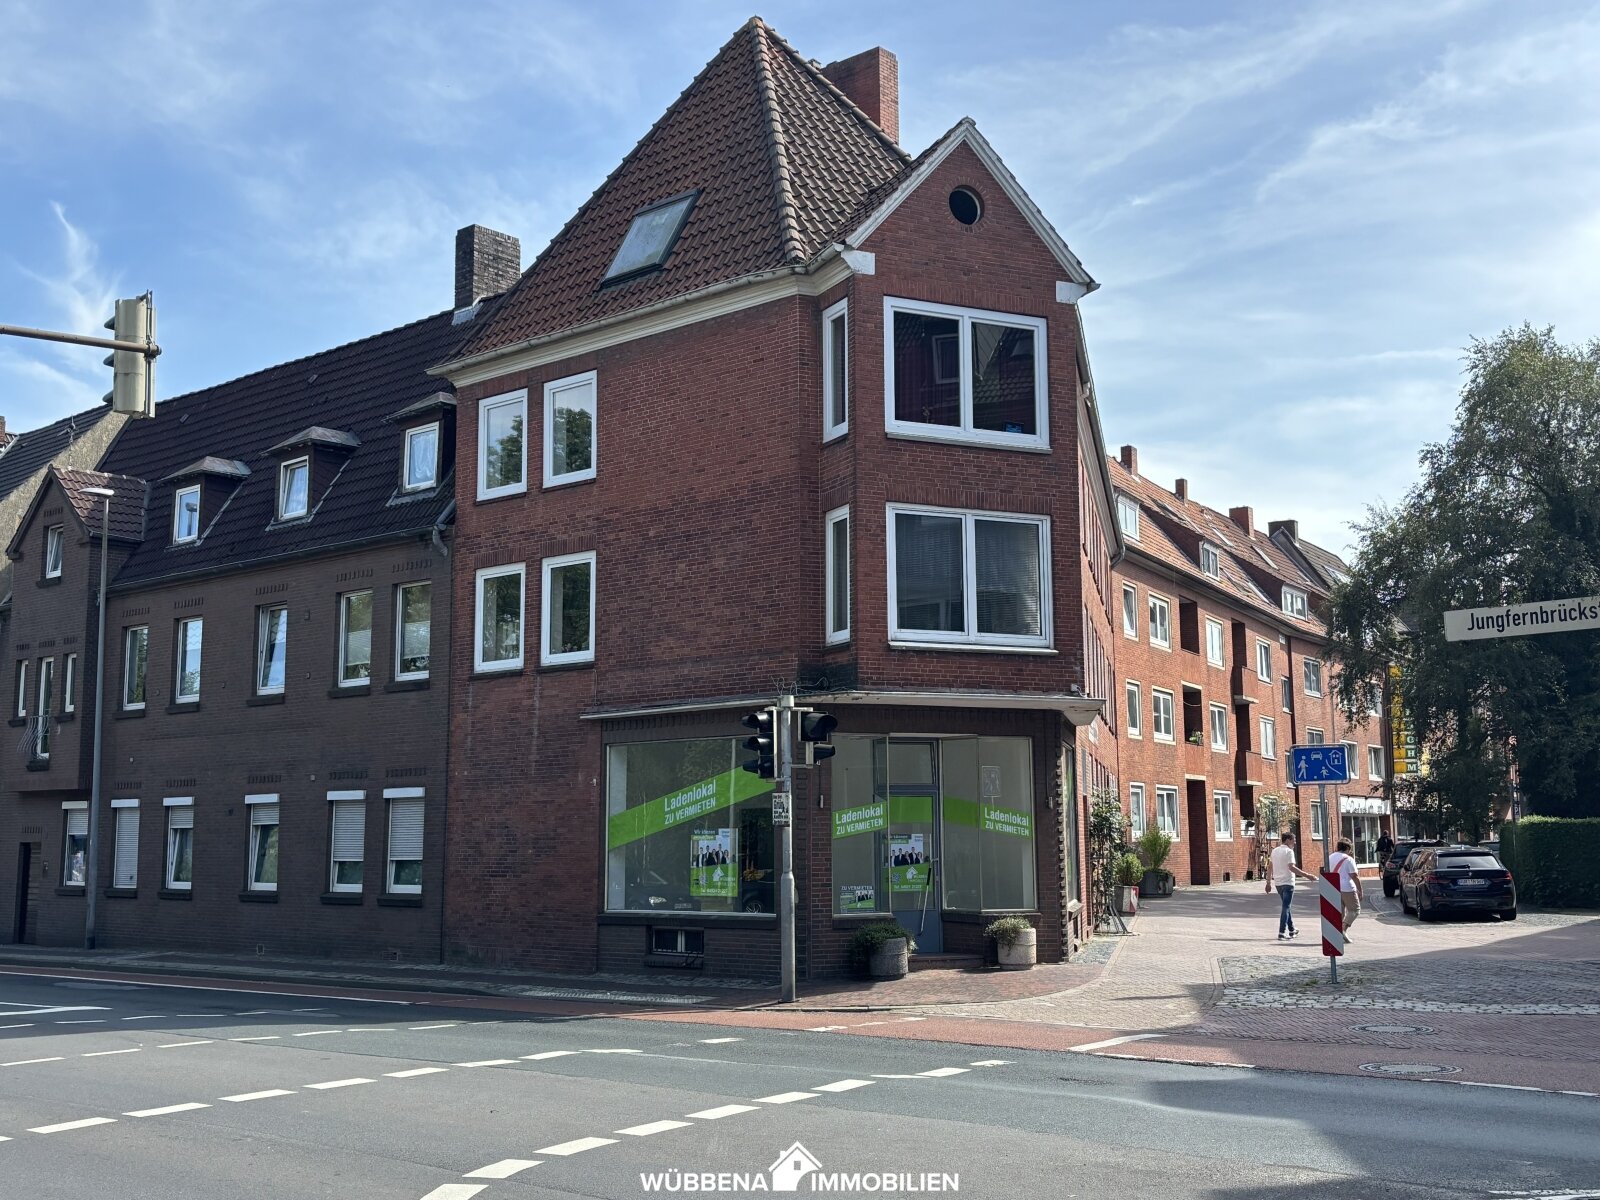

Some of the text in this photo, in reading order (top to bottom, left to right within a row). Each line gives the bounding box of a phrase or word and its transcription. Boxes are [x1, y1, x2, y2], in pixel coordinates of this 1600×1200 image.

[1467, 602, 1600, 633] Jungfernbrücks
[664, 778, 717, 812] Ladenlokal
[664, 796, 717, 825] ZU VERMIETEN
[835, 803, 883, 825] Ladenlokal
[984, 807, 1029, 827] Ladenlokal
[836, 817, 884, 835] ZU VERMIETEN
[985, 820, 1030, 837] ZU VERMIETEN
